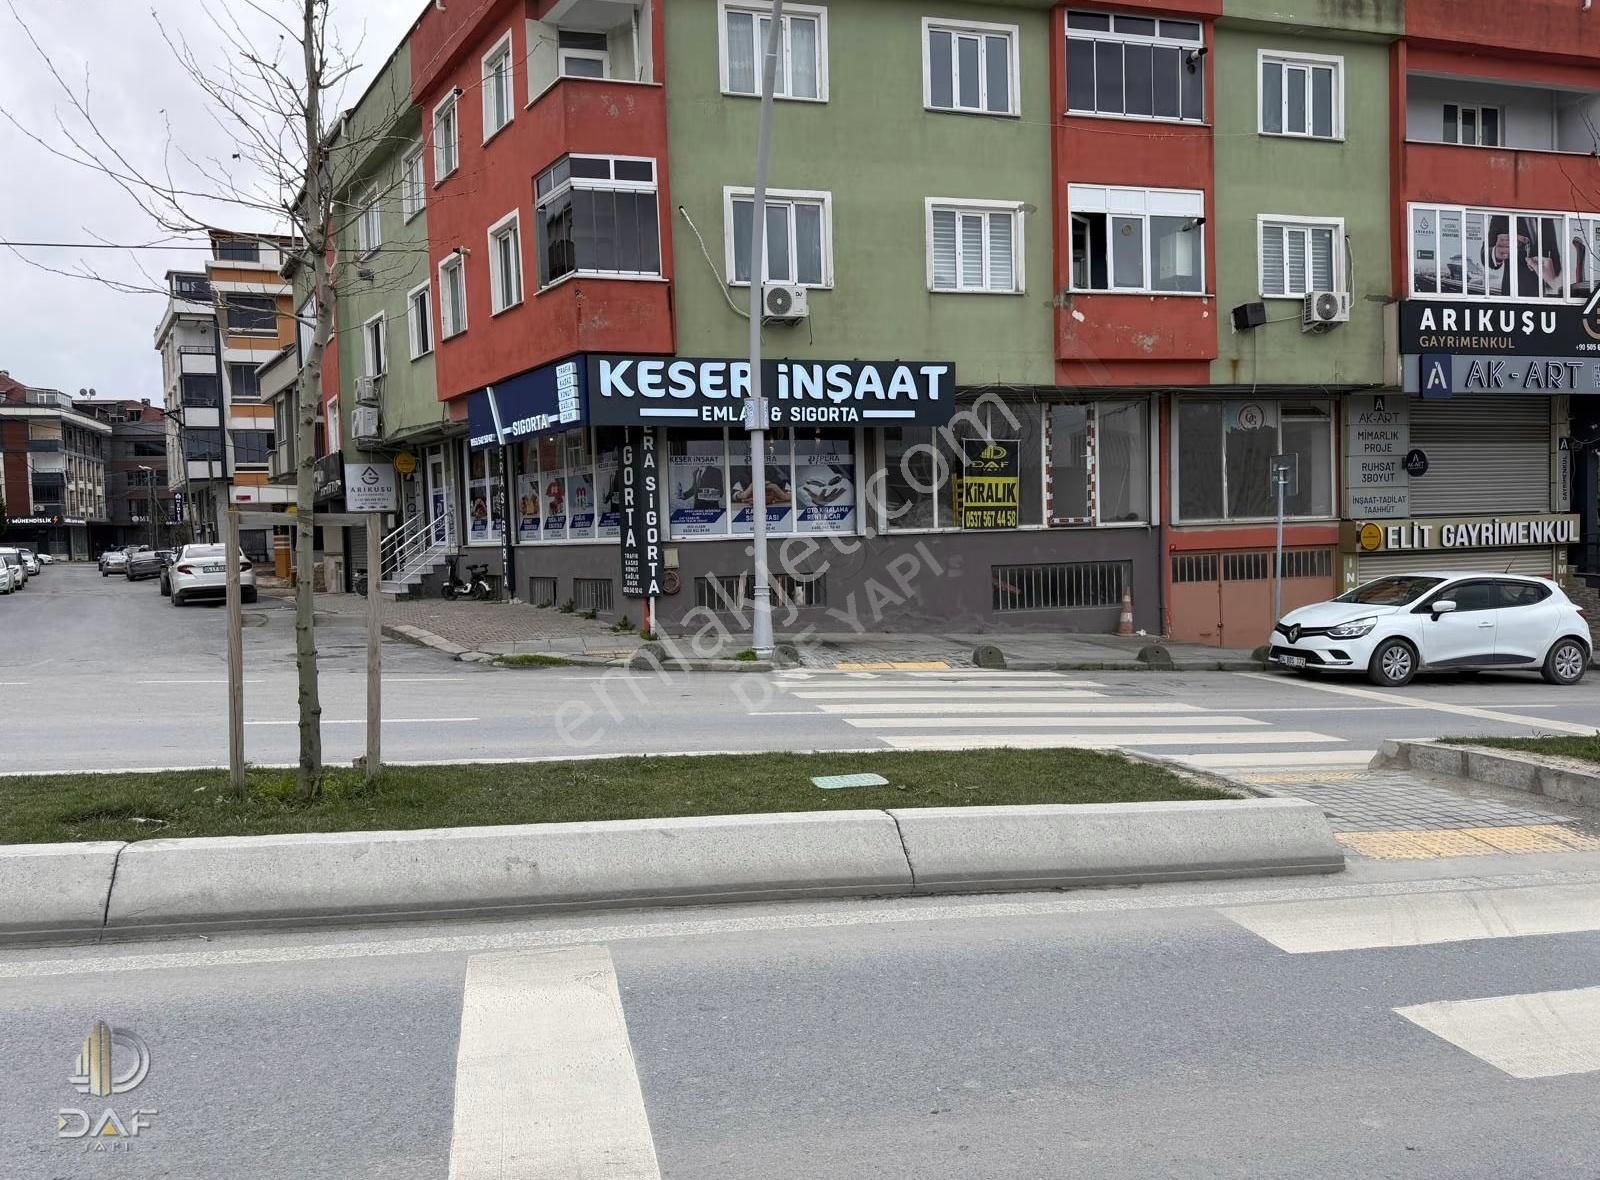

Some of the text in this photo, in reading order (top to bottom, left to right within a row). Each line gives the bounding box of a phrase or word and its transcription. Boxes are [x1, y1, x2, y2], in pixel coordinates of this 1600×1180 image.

[1420, 308, 1556, 335] ARIKUŞU
[600, 360, 752, 399] KESER
[702, 406, 748, 421] EMLA
[771, 407, 782, 421] &
[1359, 412, 1400, 423] AK-ART
[512, 414, 549, 436] SIGORTA
[1358, 430, 1400, 441] MİMARLIK
[643, 425, 655, 468] ERA
[1364, 443, 1393, 453] PROJE
[971, 460, 1009, 468] DAF
[1362, 462, 1396, 472] RUHSAT
[1364, 505, 1395, 514] TAAHHÜT
[965, 510, 1016, 528] 0537 567 44 58
